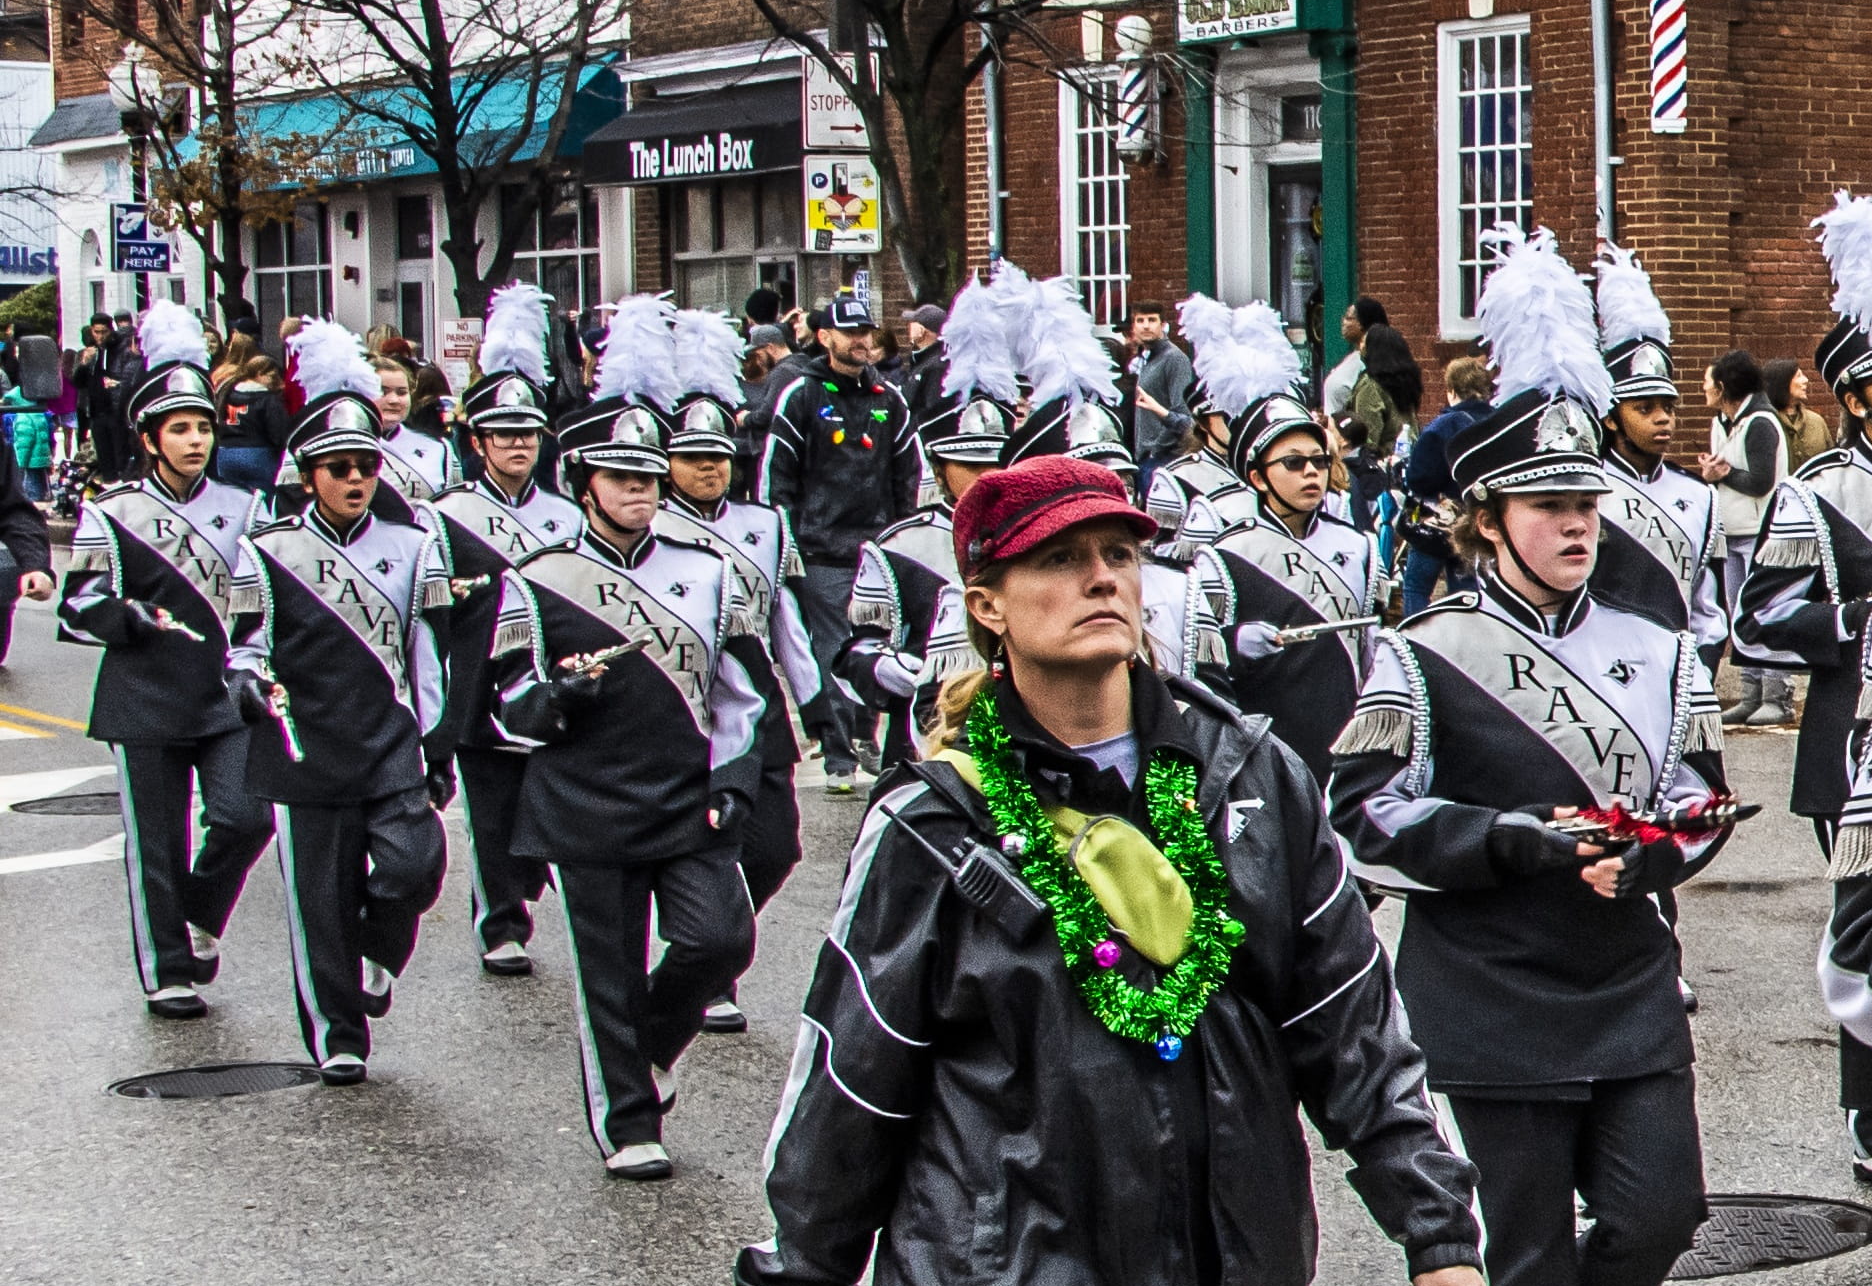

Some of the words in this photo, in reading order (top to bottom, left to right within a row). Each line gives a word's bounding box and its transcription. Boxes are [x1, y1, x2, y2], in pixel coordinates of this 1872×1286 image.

[1196, 16, 1281, 38] BARBERS
[629, 141, 660, 179] The
[662, 134, 715, 177] Lunch
[719, 132, 754, 172] Box
[129, 246, 156, 257] PAY
[123, 257, 162, 268] HERE
[456, 322, 468, 332] NO
[446, 334, 480, 344] PARKING
[152, 518, 230, 620] RAVE
